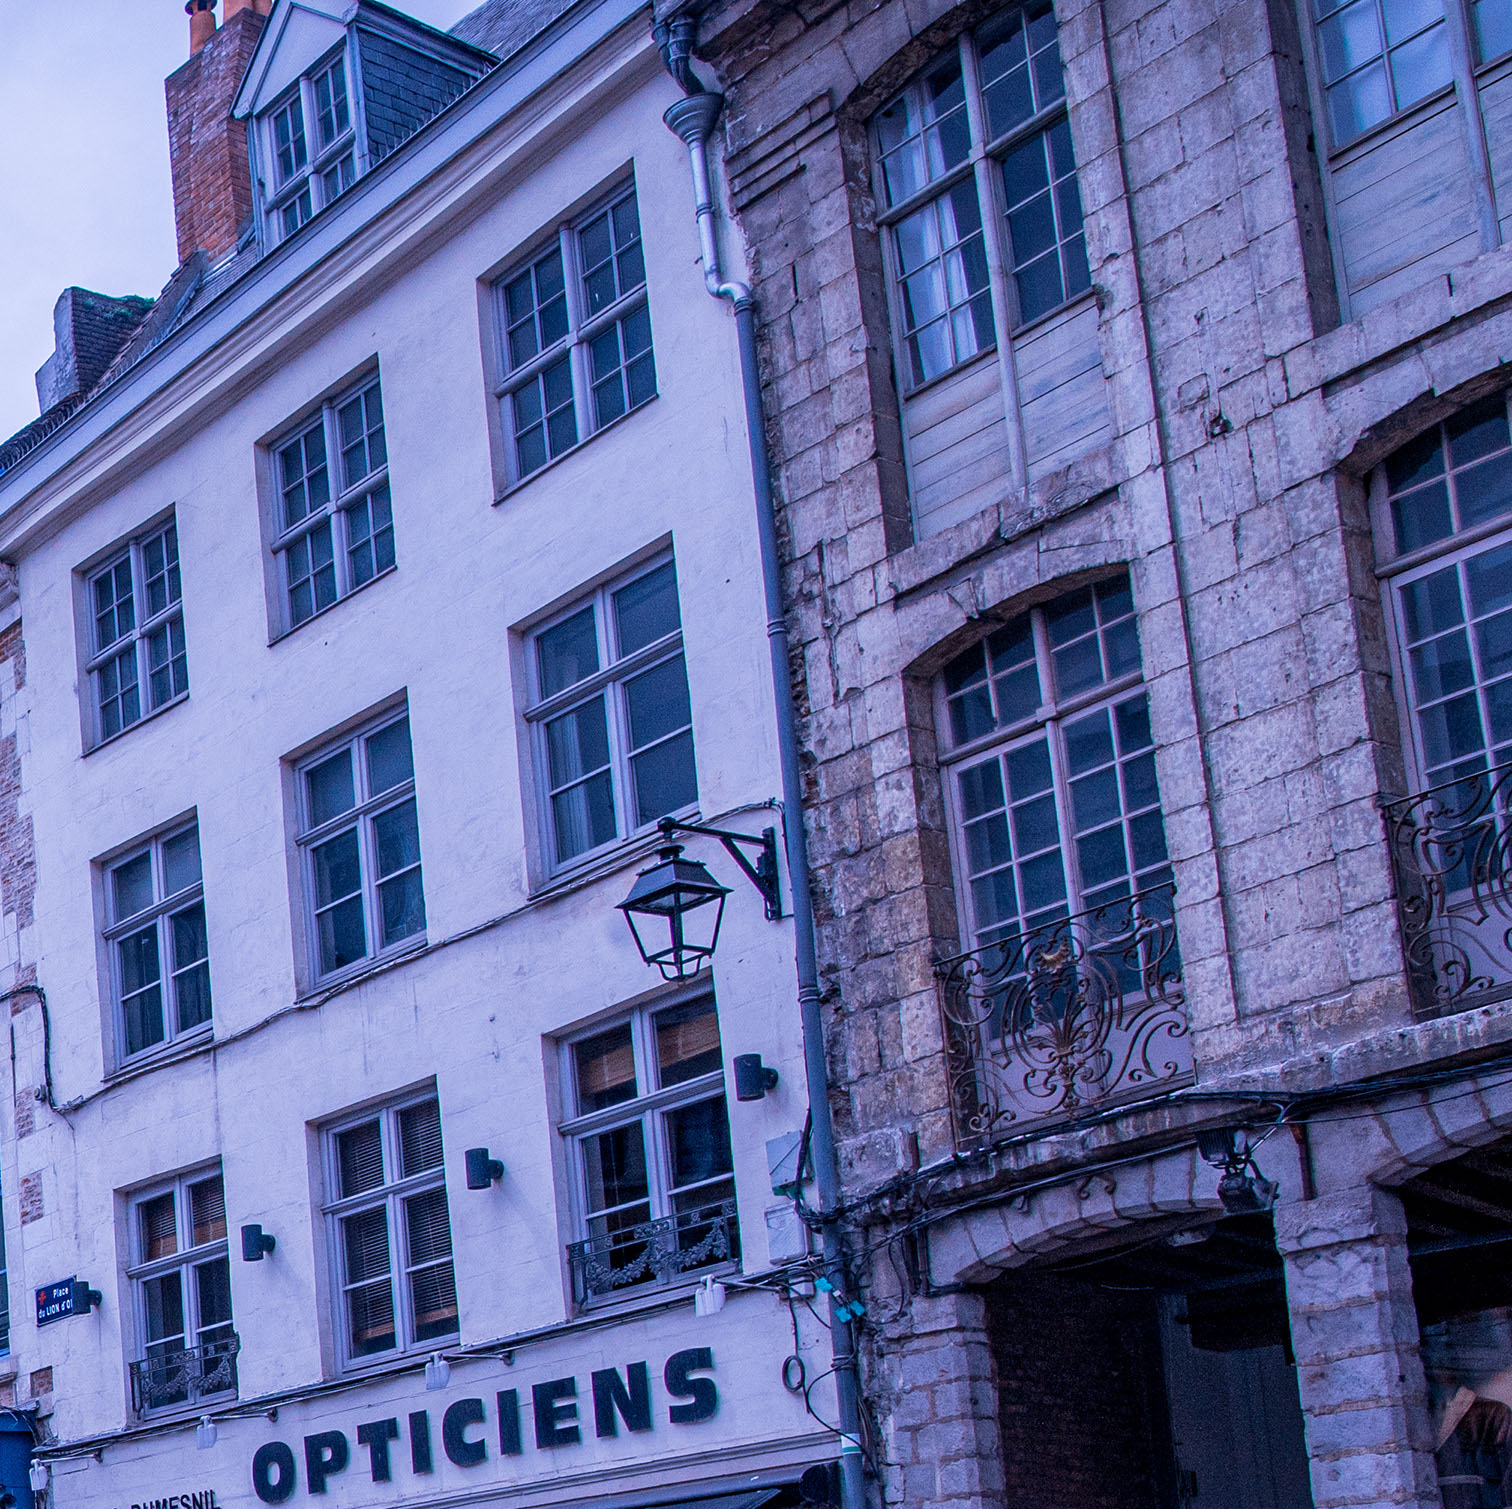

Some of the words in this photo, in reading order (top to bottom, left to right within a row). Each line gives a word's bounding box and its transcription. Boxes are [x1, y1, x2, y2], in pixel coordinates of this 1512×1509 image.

[53, 1287, 69, 1298] Place
[38, 1309, 46, 1318] du
[46, 1303, 60, 1316] LION
[251, 1345, 720, 1505] OPTICIENS
